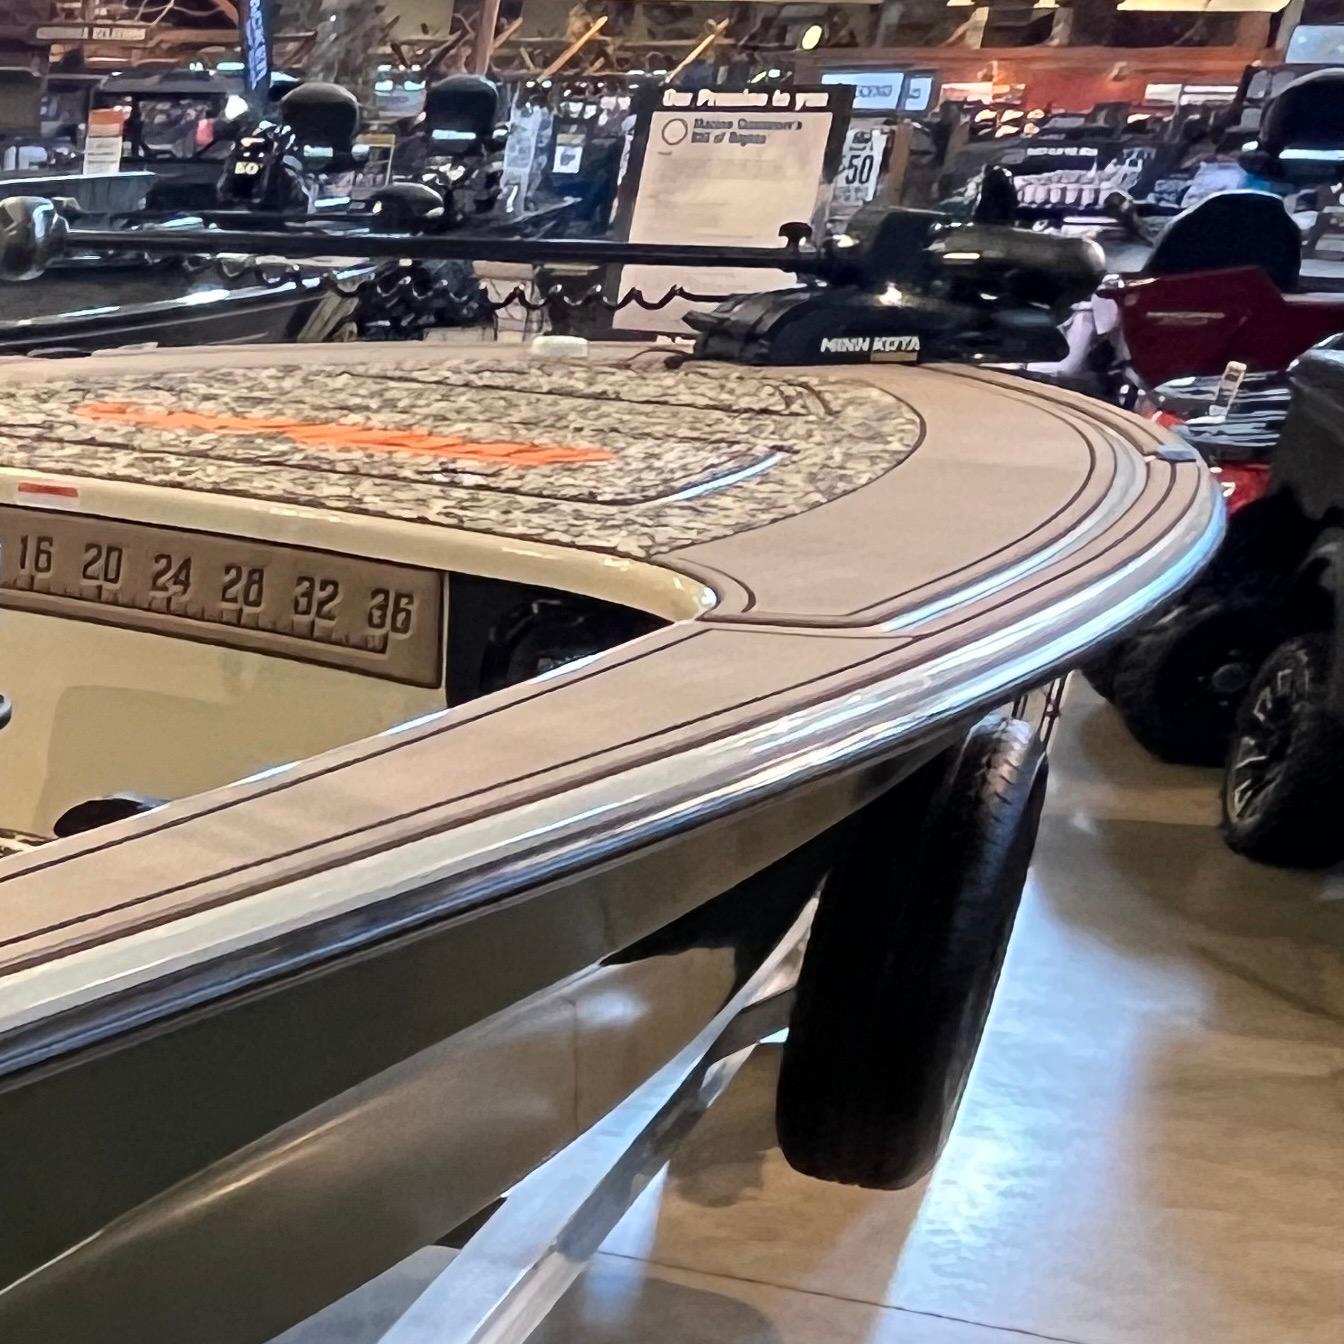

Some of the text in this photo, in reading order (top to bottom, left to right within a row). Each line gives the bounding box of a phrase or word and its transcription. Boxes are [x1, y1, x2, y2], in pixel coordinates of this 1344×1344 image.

[872, 335, 921, 352] KOTA
[19, 534, 413, 634] 16 20 24 28 32 36
